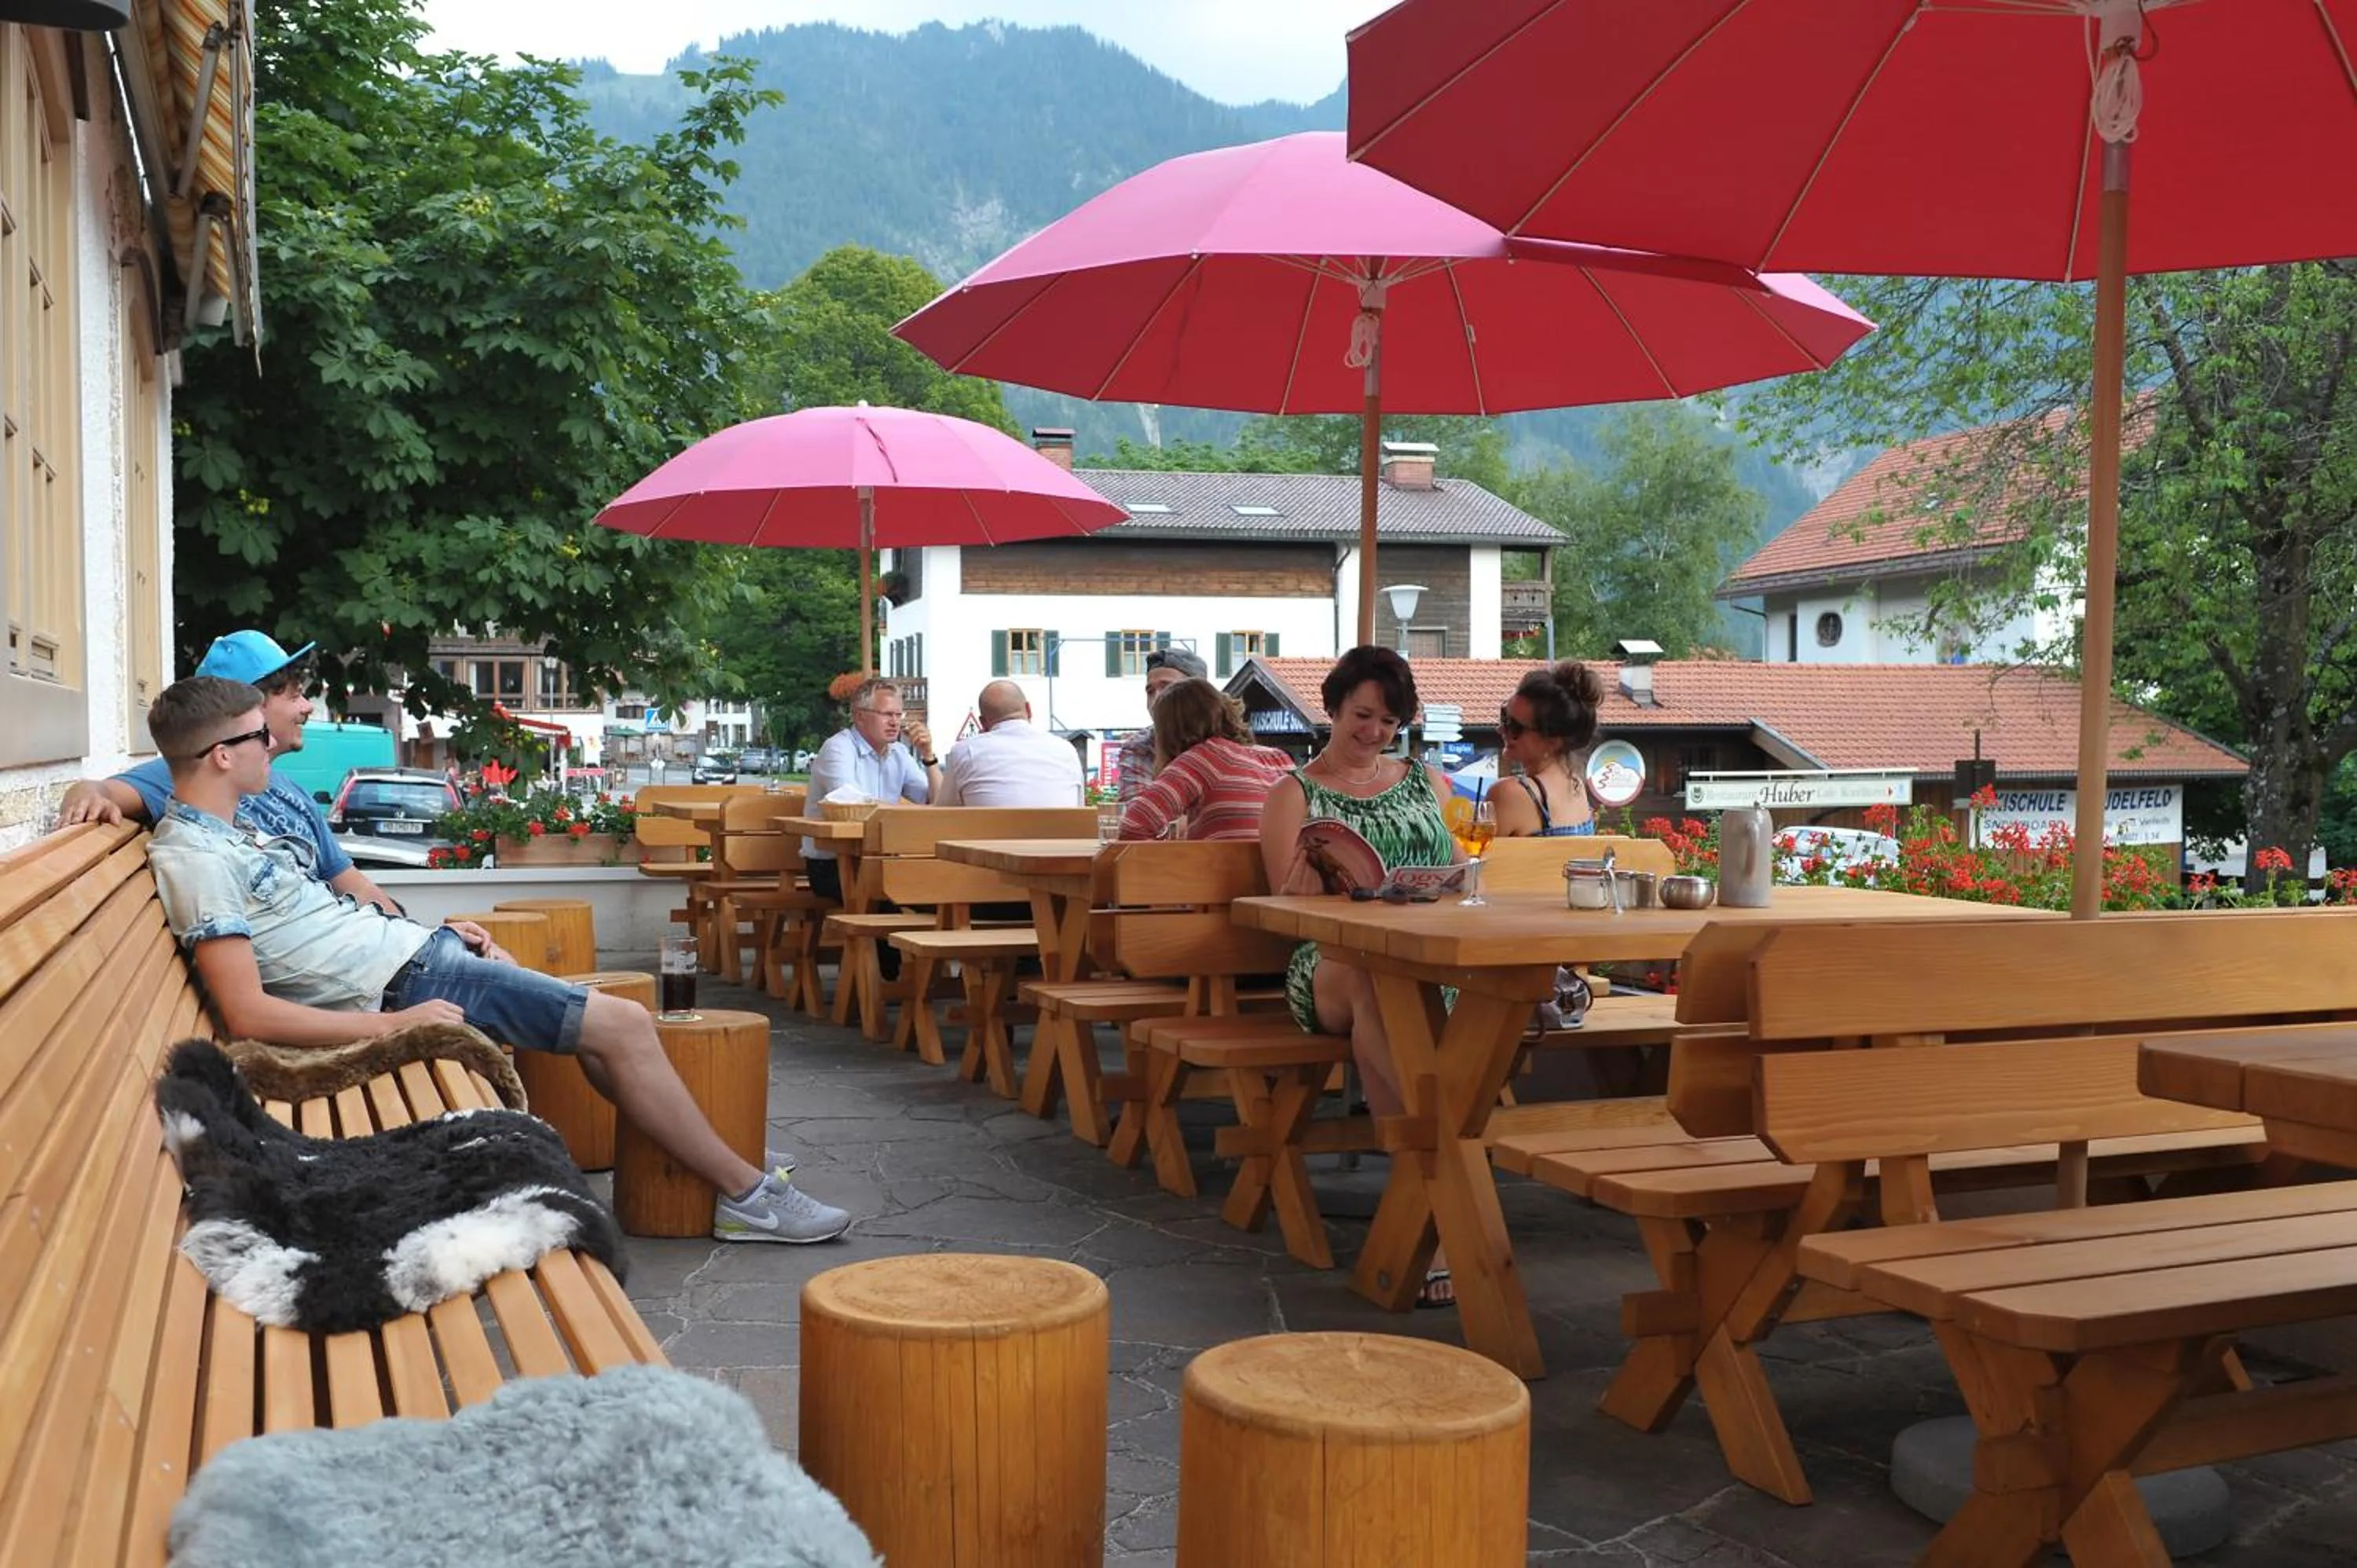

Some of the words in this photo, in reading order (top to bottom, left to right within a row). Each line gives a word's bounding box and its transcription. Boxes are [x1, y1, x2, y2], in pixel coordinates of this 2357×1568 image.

[1759, 780, 1816, 803] Huber
[1985, 793, 2066, 811] KISCHULE
[2104, 789, 2172, 810] UDELFELD
